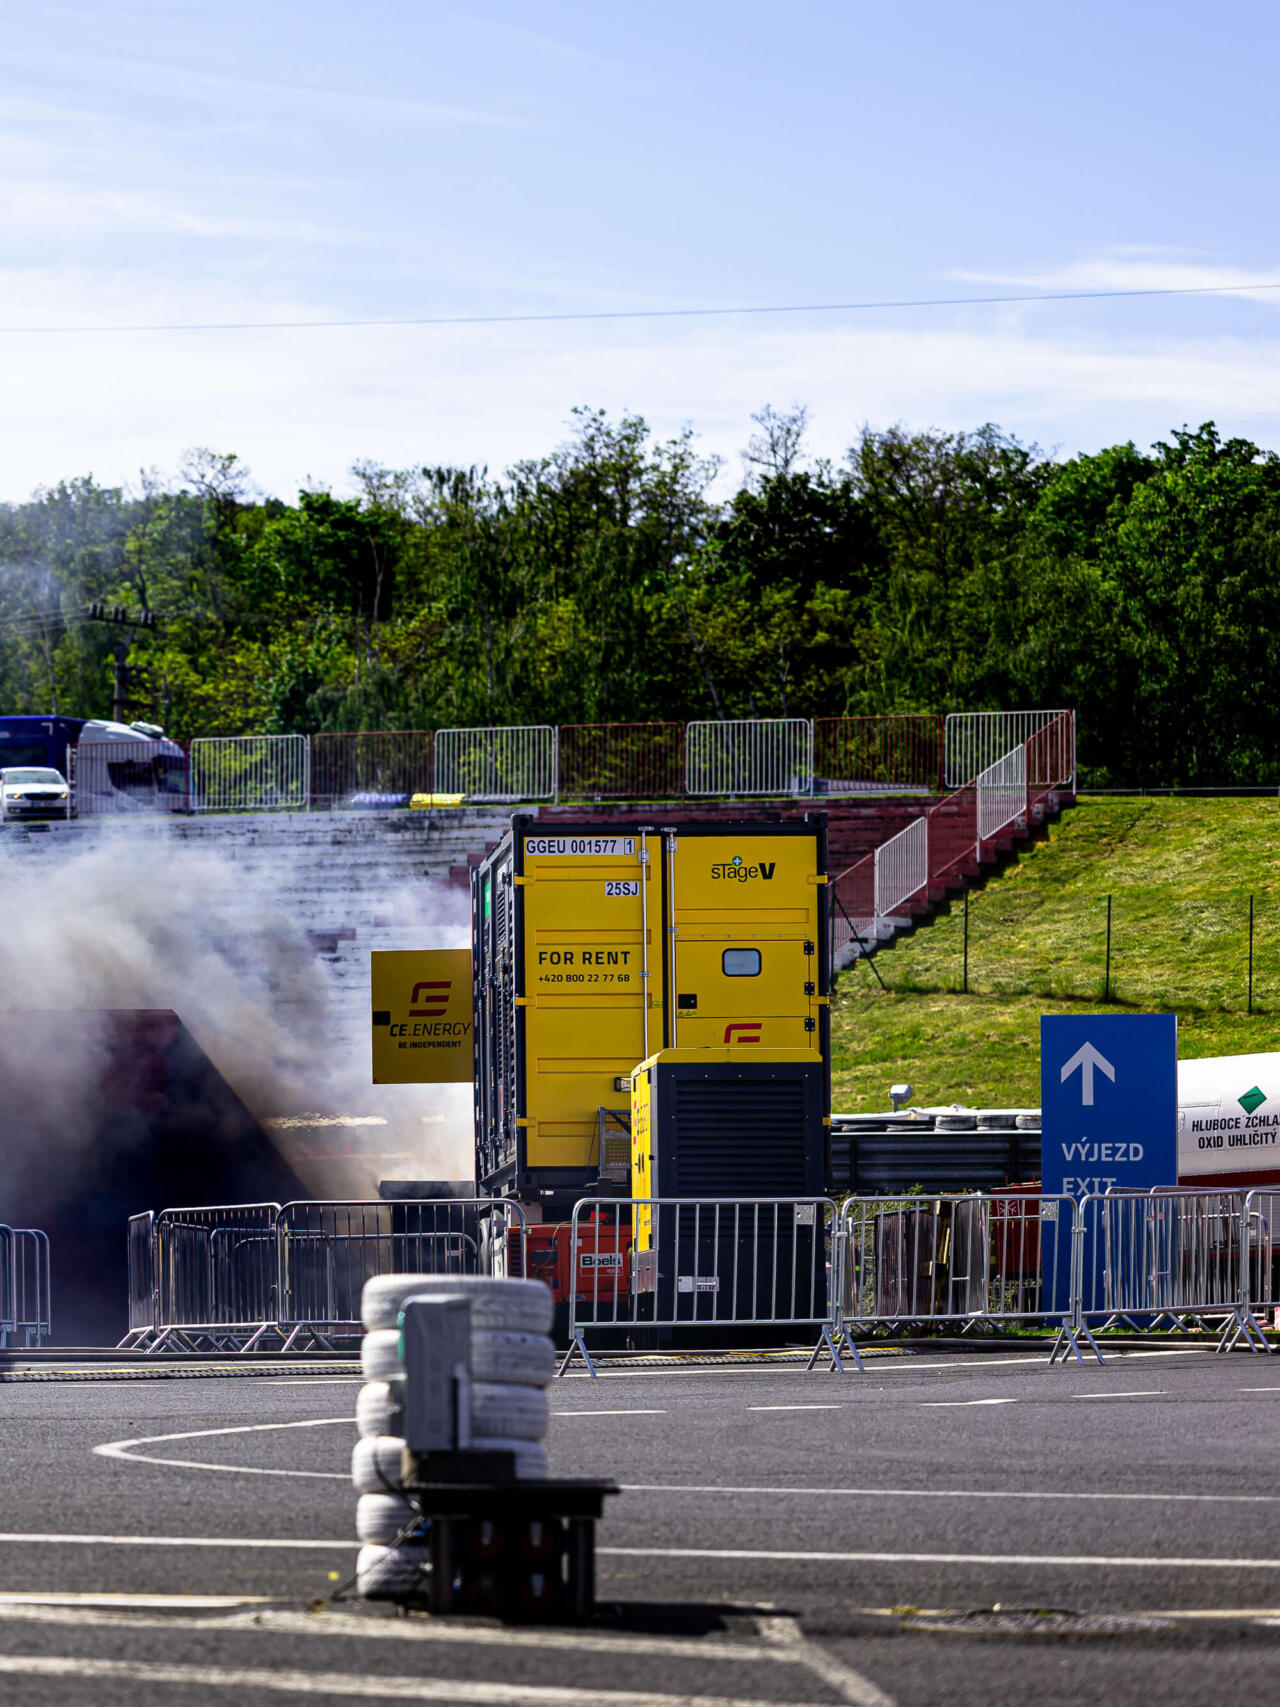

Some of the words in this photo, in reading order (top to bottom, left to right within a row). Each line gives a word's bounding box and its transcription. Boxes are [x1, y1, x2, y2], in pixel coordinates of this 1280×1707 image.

[526, 839, 566, 854] GGEU
[571, 839, 617, 854] 001577
[606, 882, 638, 896] 25SJ
[538, 951, 574, 965] FOR
[582, 951, 631, 965] RENT
[538, 974, 563, 983] +420
[565, 974, 585, 983] 800
[587, 974, 599, 983] 22
[602, 974, 614, 983] 77
[617, 974, 630, 983] 68
[389, 1022, 472, 1037] CE.ENERGY
[398, 1041, 408, 1049] BE
[1191, 1117, 1241, 1132] HLUBOCE
[1245, 1114, 1280, 1128] ZCHLA
[1198, 1136, 1223, 1149] OXID
[1228, 1128, 1277, 1147] UHLIČITÝ
[1061, 1136, 1144, 1162] VÝJEZD
[1063, 1177, 1117, 1196] EXIT
[582, 1255, 621, 1266] Boels
